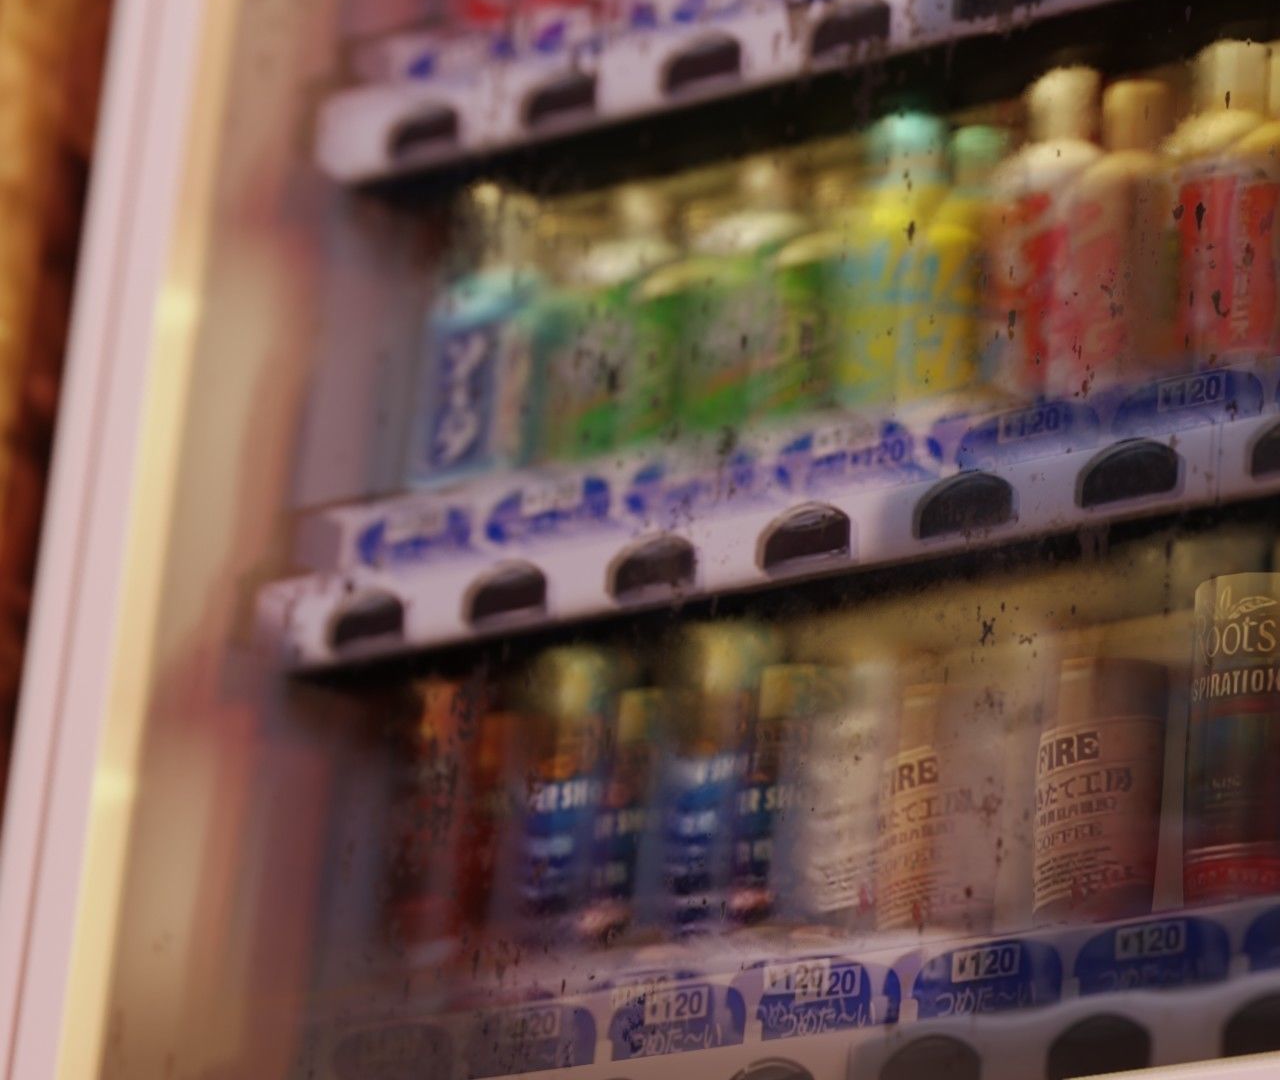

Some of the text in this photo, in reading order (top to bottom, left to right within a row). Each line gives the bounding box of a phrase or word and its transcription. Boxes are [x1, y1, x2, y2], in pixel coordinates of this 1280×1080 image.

[1162, 375, 1221, 408] ¥120
[1040, 731, 1099, 773] FIRE
[1119, 925, 1183, 954] ¥120
[957, 948, 1015, 978] ¥120
